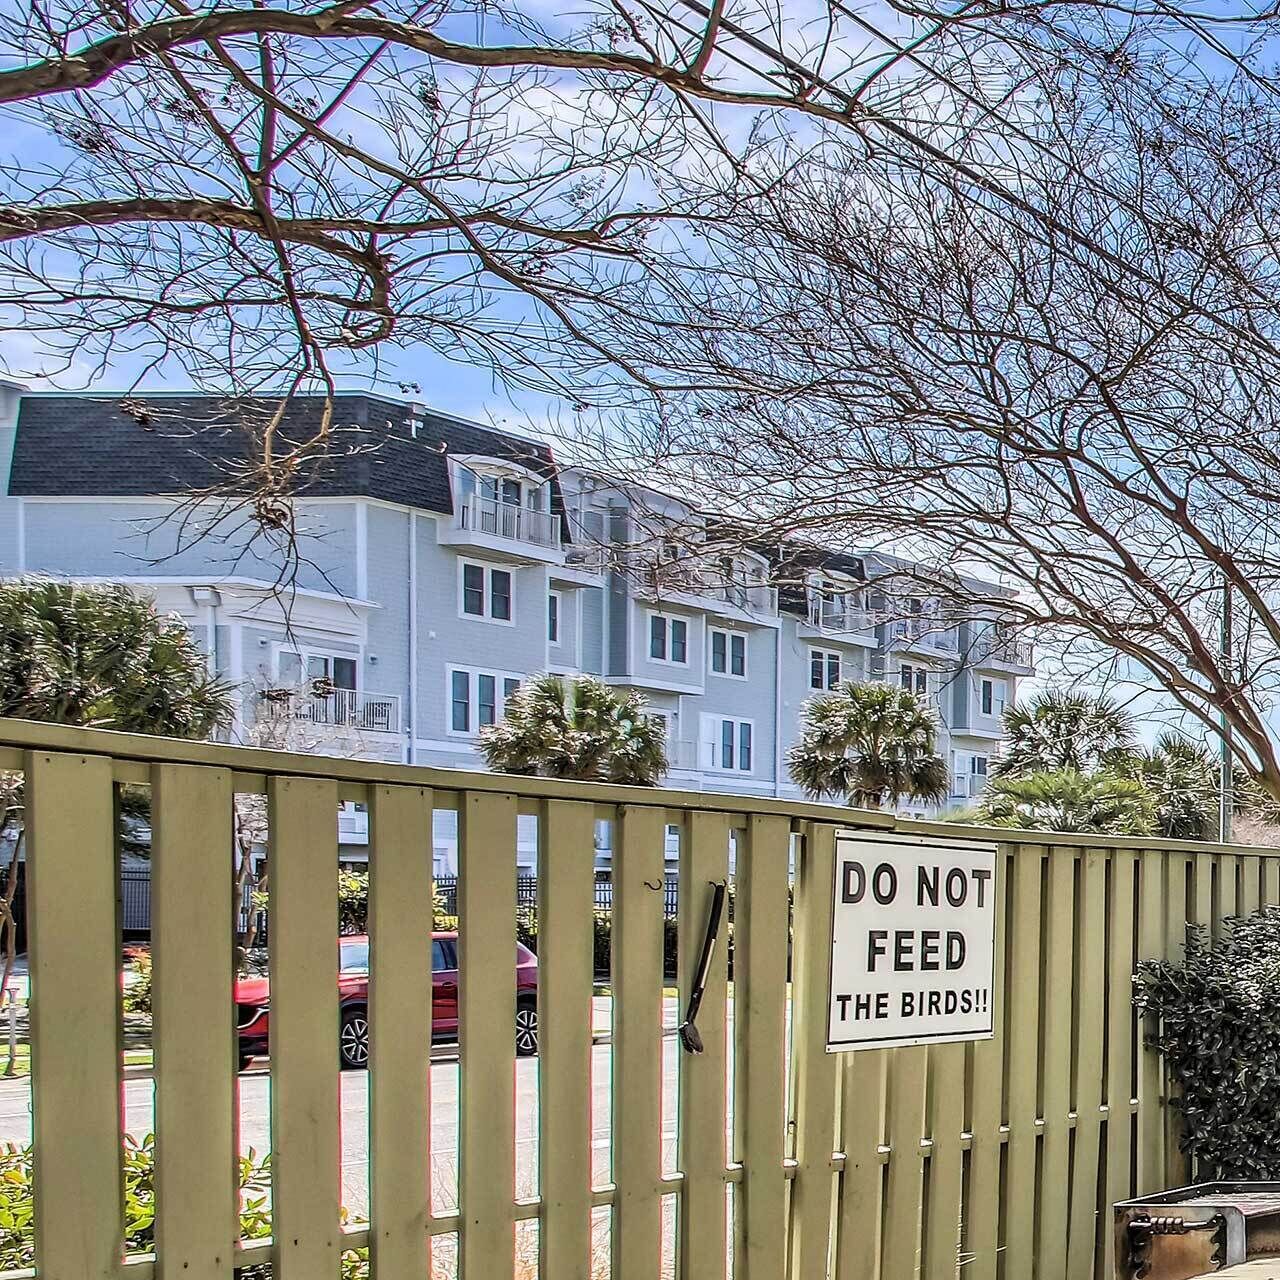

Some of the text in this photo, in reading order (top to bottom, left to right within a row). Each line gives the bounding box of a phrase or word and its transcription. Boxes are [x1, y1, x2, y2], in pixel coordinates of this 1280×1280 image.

[841, 860, 992, 908] DO NOT
[867, 930, 967, 972] FEED
[836, 989, 988, 1021] THE BIRDS!!
